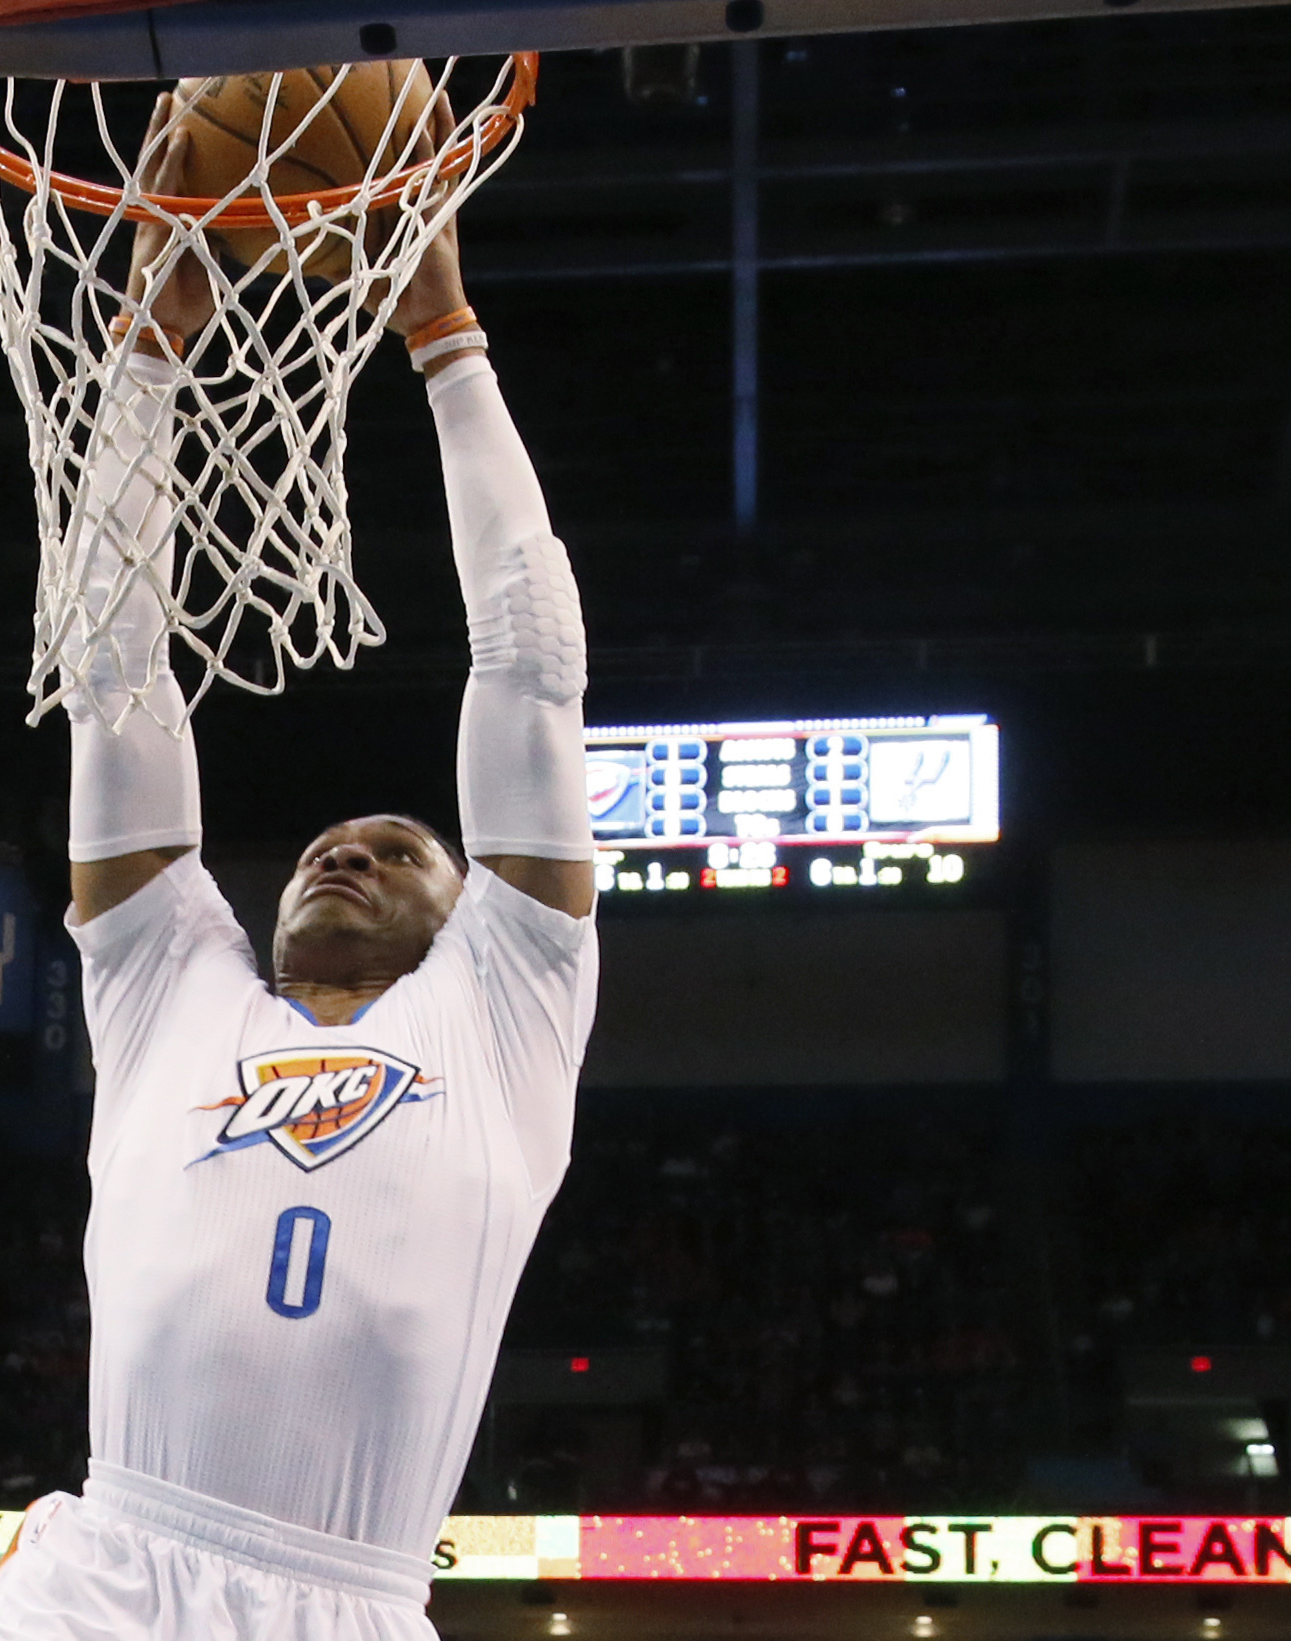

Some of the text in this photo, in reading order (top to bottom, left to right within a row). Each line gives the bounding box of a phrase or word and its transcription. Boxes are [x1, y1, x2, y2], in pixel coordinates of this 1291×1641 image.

[220, 1064, 378, 1140] OKC
[266, 1206, 331, 1319] 0
[794, 1521, 1000, 1577] FAST,
